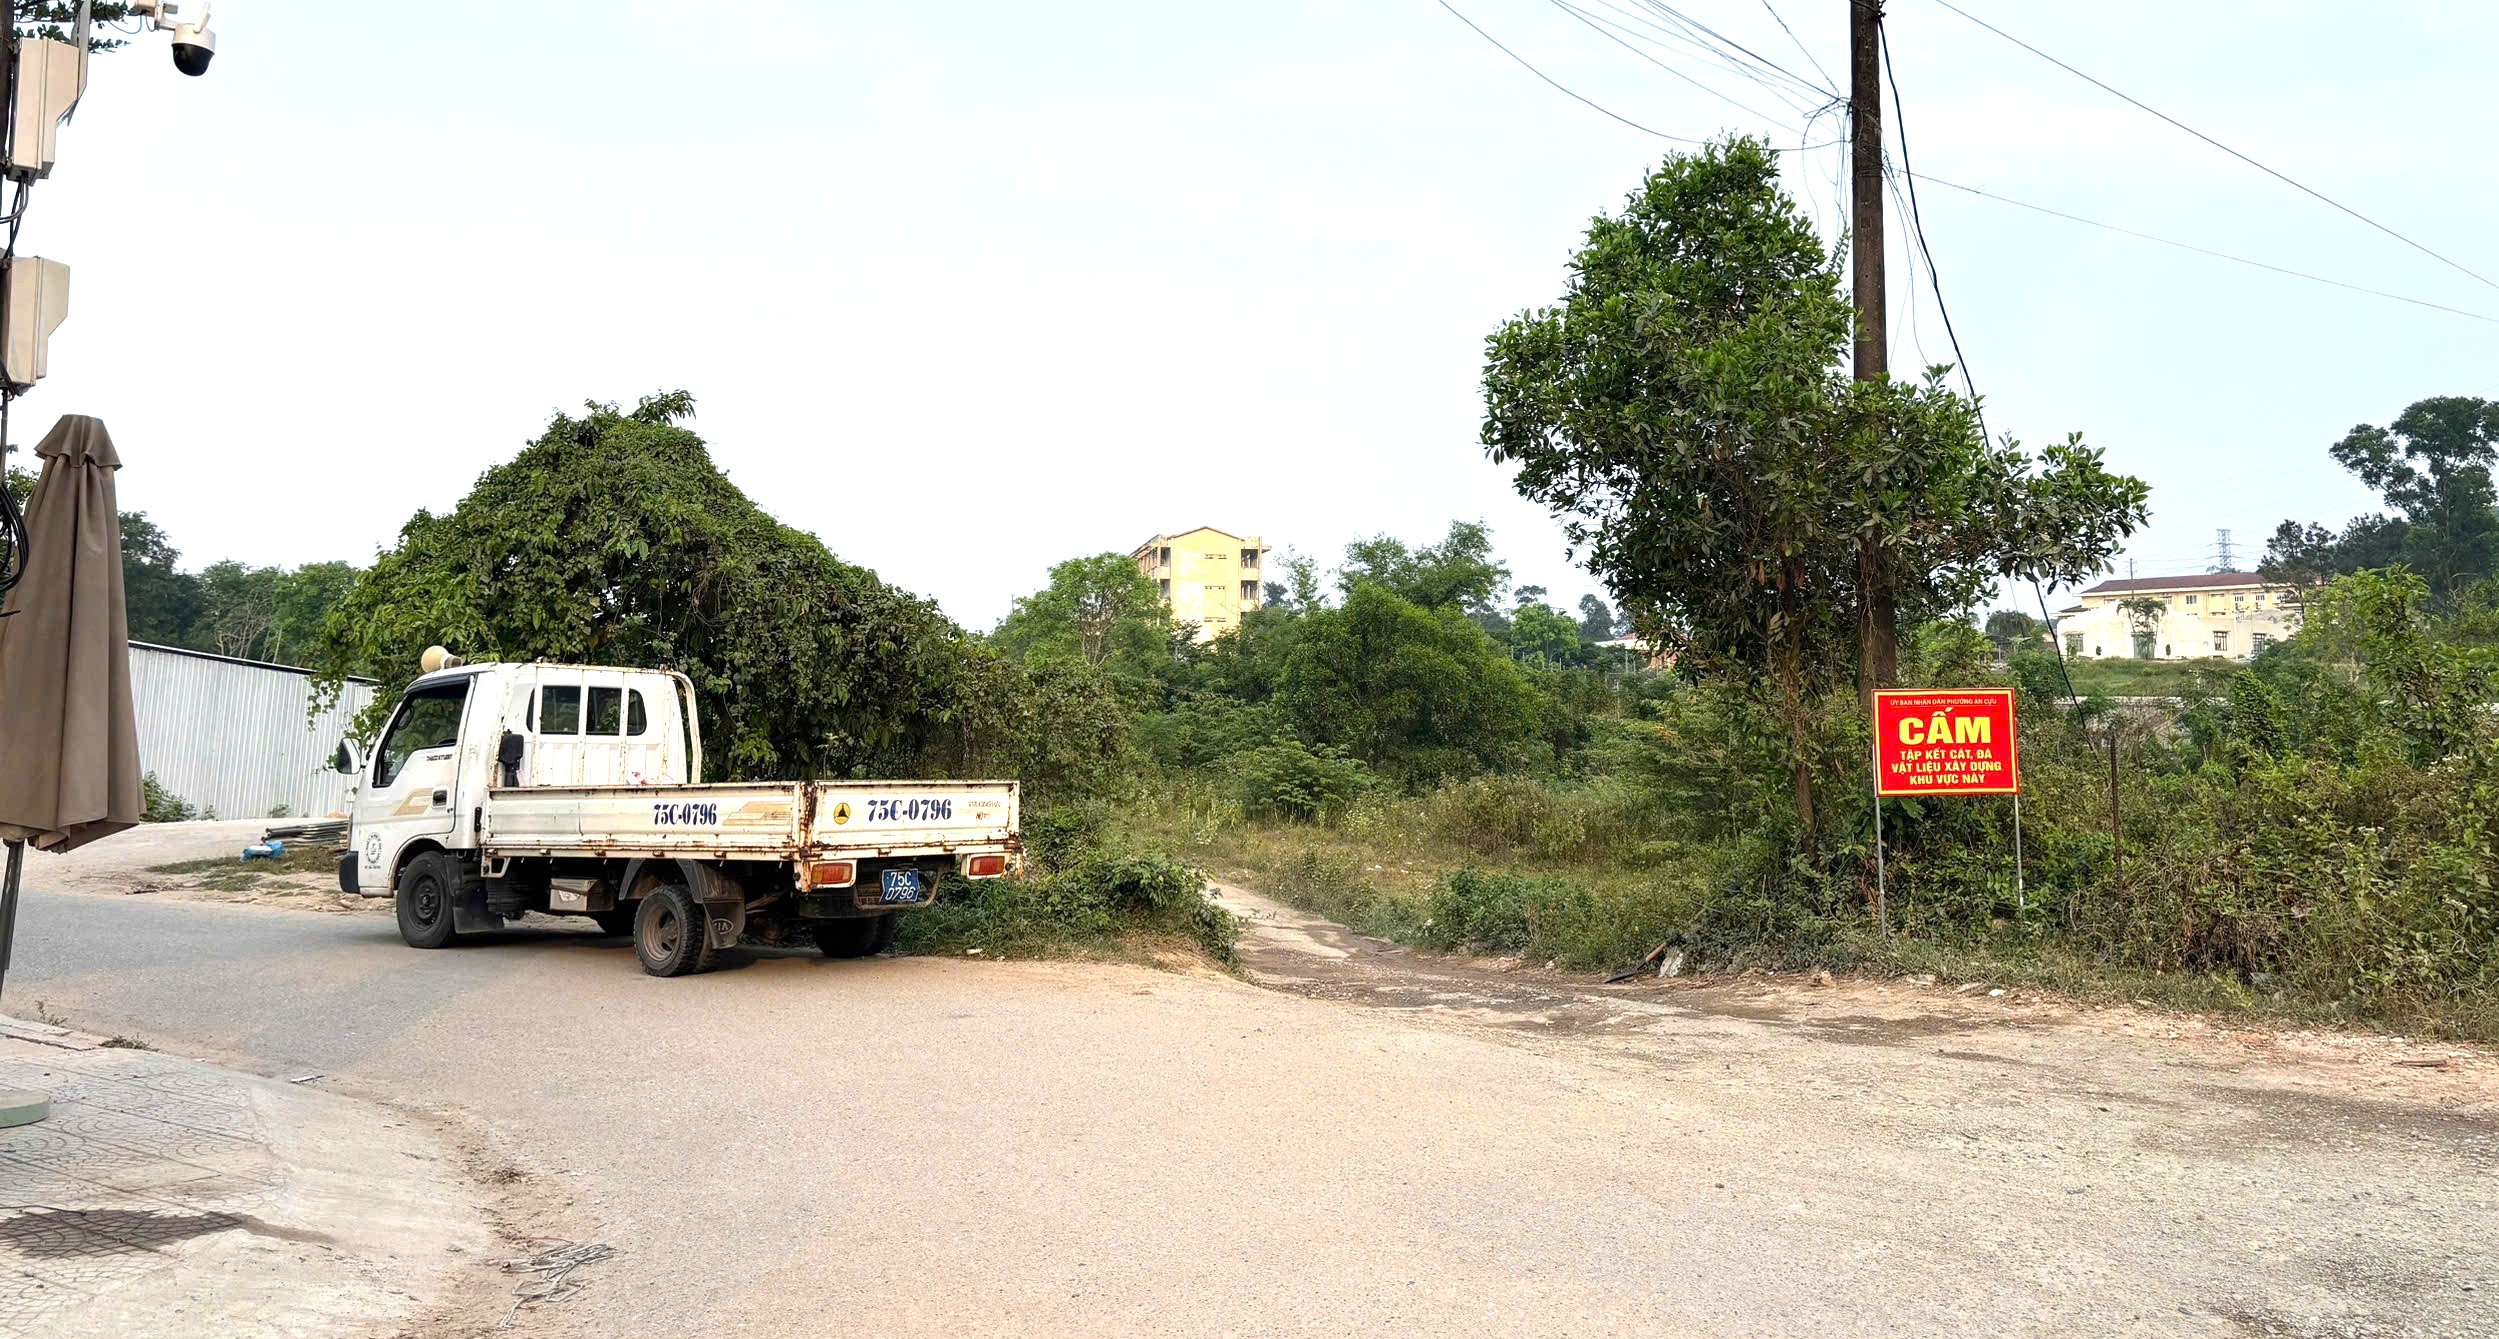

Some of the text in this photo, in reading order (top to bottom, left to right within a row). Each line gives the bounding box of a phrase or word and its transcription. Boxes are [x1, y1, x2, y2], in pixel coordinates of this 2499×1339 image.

[1900, 698, 1913, 706] BAN
[1898, 706, 1991, 745] CẤM
[1900, 746, 1992, 762] TẬP KẾT CÁT, ĐÁ
[1891, 760, 2002, 775] VẬT LIỆU XÂY DỰNG
[1909, 772, 1985, 786] KHU VỰC NÀY
[653, 803, 717, 826] 75C-0796
[867, 798, 952, 822] 75C-0796
[889, 871, 912, 886] 75C
[886, 886, 916, 902] 0796
